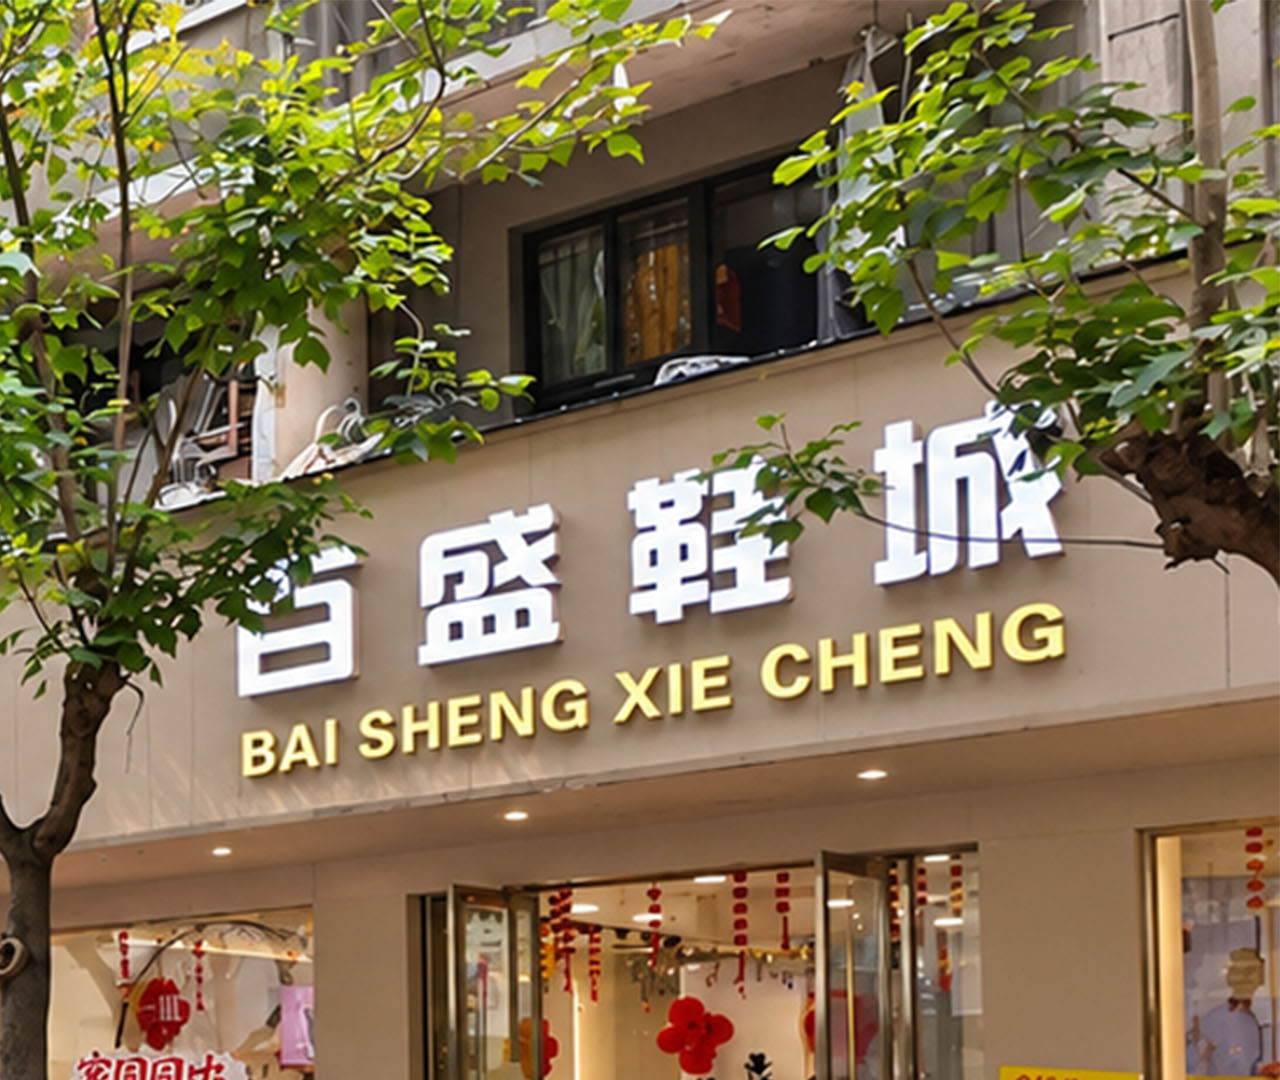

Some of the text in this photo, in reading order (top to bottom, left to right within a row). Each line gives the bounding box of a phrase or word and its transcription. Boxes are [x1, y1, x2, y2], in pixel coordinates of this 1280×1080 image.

[242, 602, 1067, 778] BAI SHENG XIE CHENG
